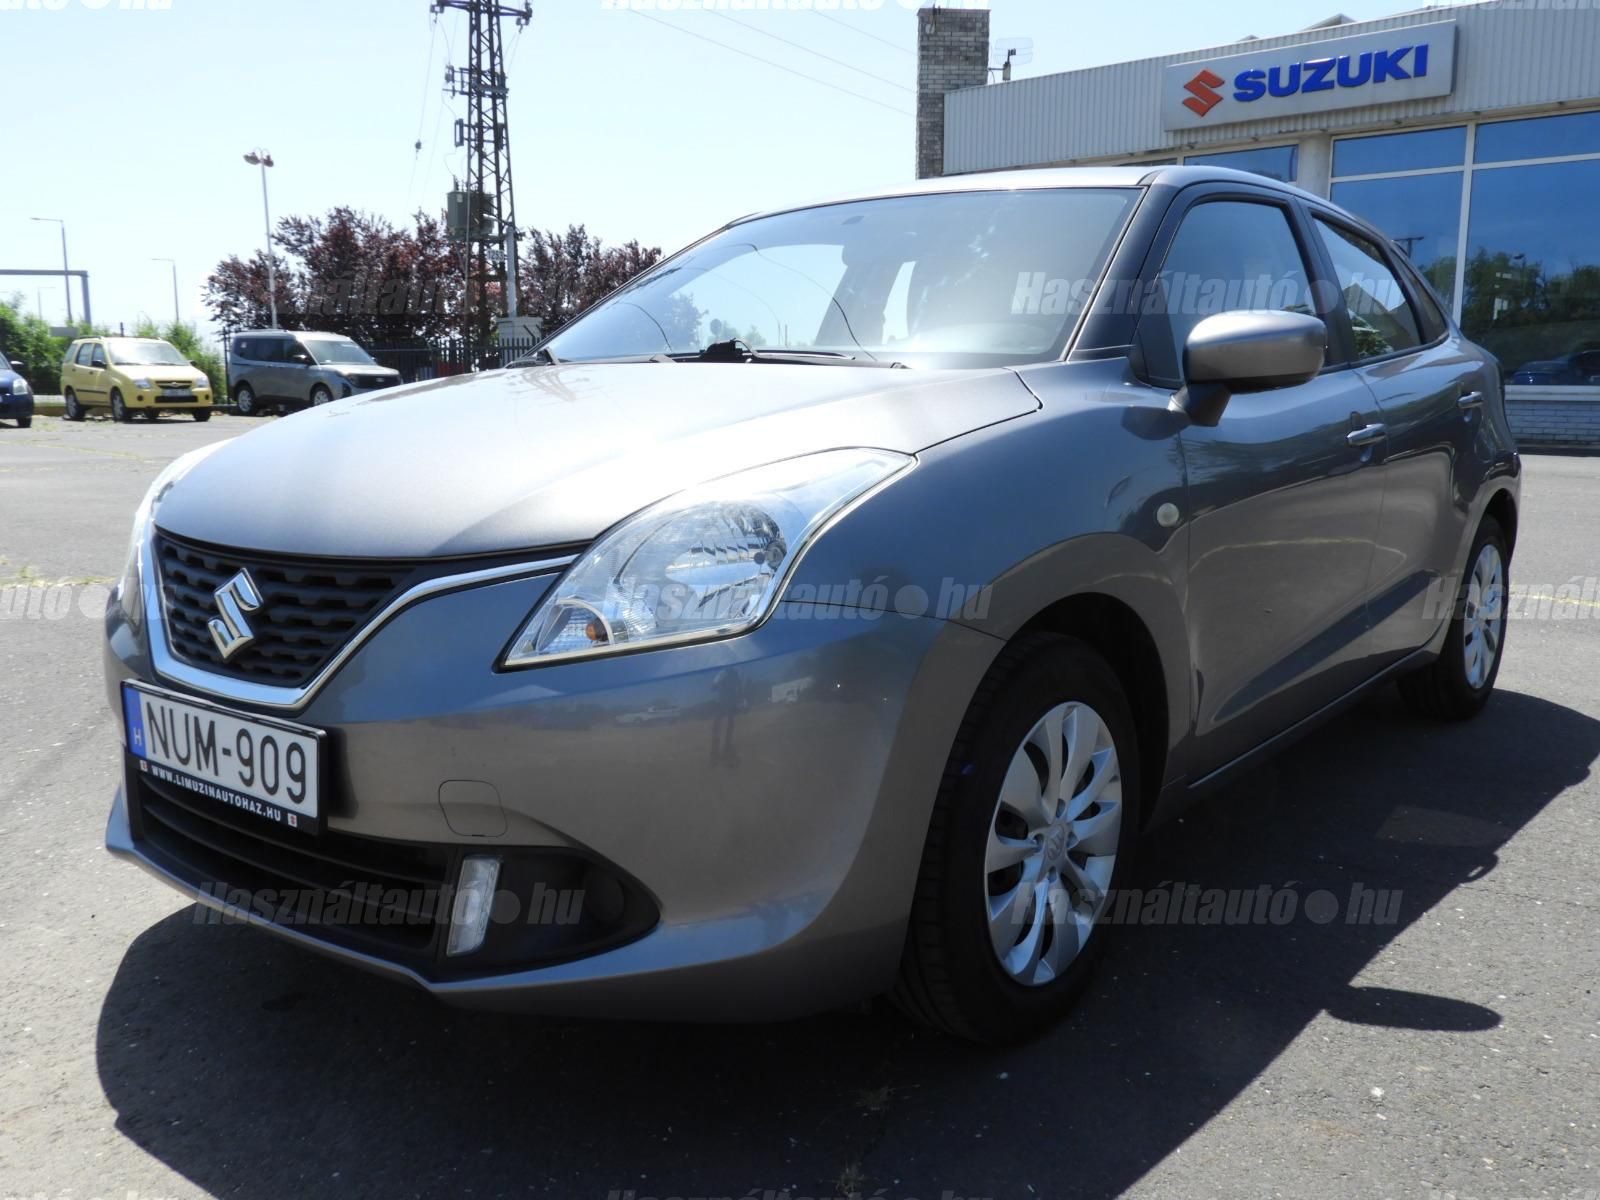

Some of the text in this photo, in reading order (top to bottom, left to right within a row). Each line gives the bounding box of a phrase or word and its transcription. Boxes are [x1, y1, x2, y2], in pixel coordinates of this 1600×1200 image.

[1233, 44, 1429, 102] SUZUKI
[133, 727, 142, 747] H
[146, 702, 306, 804] NUM-909
[151, 764, 281, 822] WWW.LIMUZINAUTOHAZ.HU
